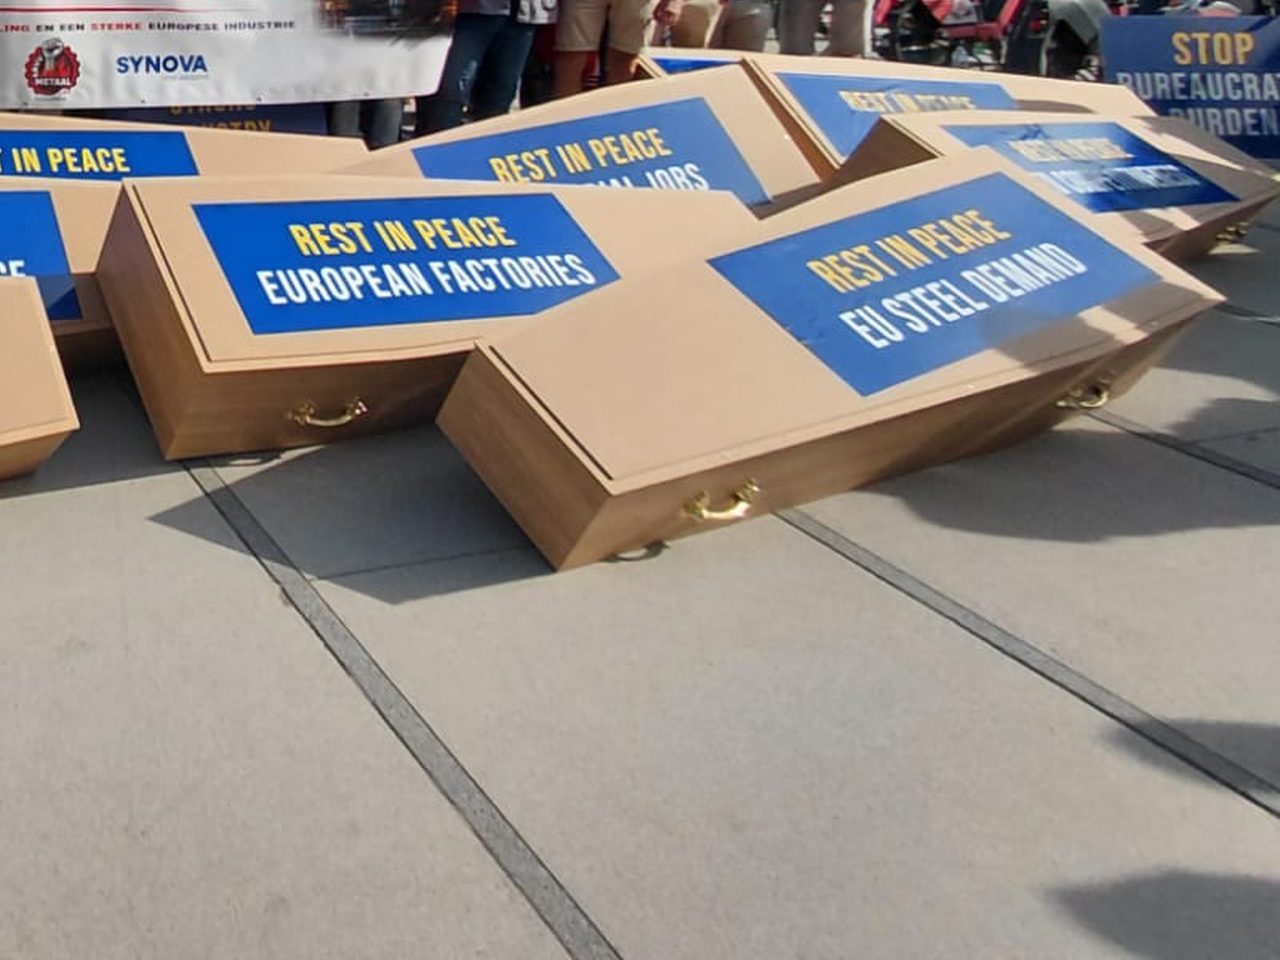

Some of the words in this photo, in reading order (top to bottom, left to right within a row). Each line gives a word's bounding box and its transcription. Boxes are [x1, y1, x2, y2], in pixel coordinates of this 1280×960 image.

[36, 22, 55, 32] EN
[59, 21, 85, 32] EEN
[90, 20, 143, 32] STERKE
[148, 20, 219, 31] EUROPESE
[224, 19, 295, 31] INDUSTRIE
[116, 53, 208, 75] SYNOVA
[1171, 31, 1255, 66] STOP
[1116, 71, 1280, 102] BUREAUCRA
[13, 148, 42, 173] IN
[50, 148, 131, 173] PEACE
[489, 148, 558, 184] REST
[556, 141, 593, 174] IN
[587, 128, 673, 168] PEACE
[288, 222, 374, 257] REST
[373, 220, 418, 252] IN
[412, 216, 517, 250] PEACE
[806, 245, 898, 293] REST
[875, 234, 933, 271] IN
[907, 209, 1013, 259] PEACE
[256, 261, 435, 305] EUROPEAN
[427, 253, 597, 294] FACTORIES
[838, 304, 905, 349] EU
[880, 279, 991, 333] STEEL
[959, 242, 1088, 303] DEMAND
